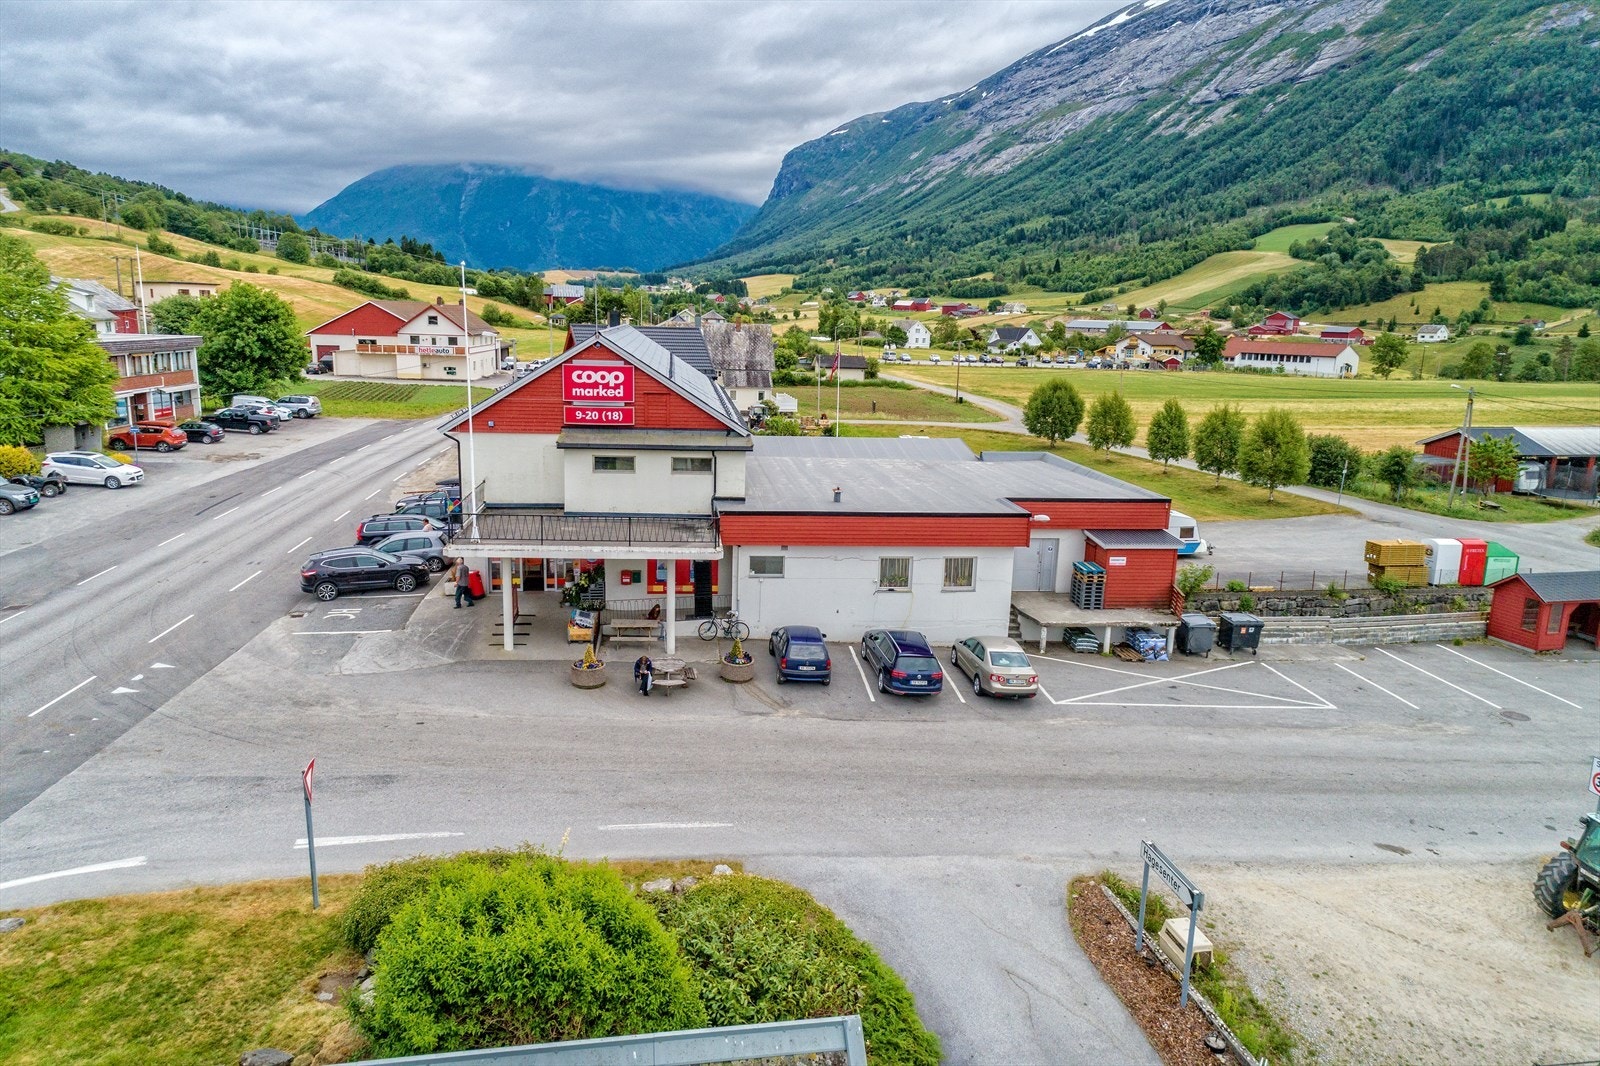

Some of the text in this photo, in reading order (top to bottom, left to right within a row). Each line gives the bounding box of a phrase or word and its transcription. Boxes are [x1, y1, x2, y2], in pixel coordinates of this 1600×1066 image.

[572, 370, 625, 387] coop
[572, 385, 624, 397] marked
[575, 411, 623, 422] 9-20 (18)
[1143, 846, 1181, 892] Hagesenter
